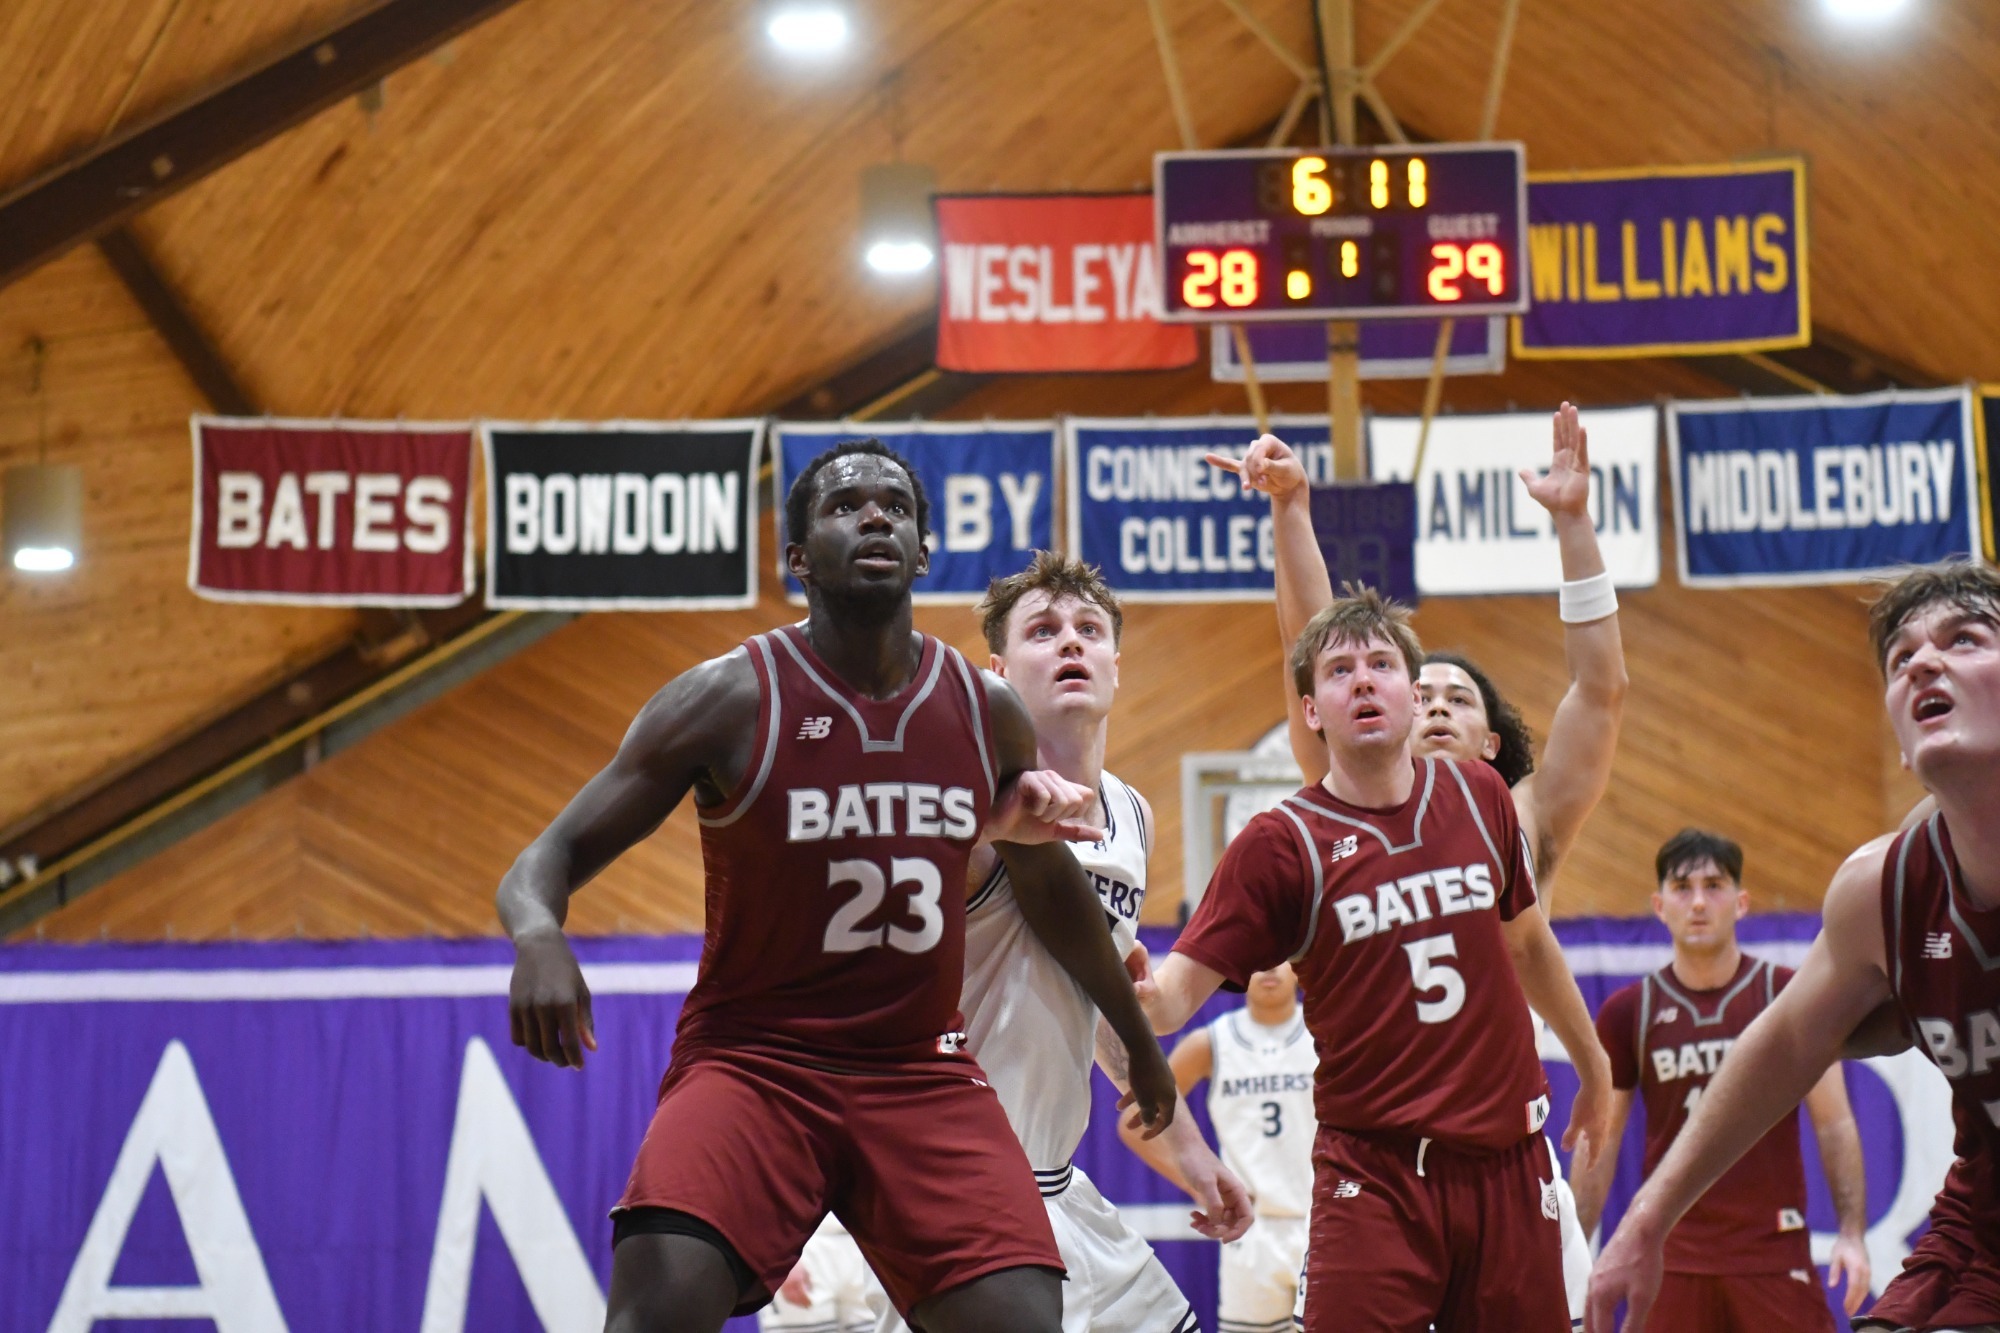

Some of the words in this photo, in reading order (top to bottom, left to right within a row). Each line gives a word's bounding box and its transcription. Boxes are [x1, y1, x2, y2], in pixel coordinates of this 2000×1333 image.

[1292, 157, 1332, 216] 6
[1427, 213, 1498, 240] GUEST
[945, 243, 1163, 322] WESLEYA
[1183, 250, 1258, 308] 28
[1341, 241, 1358, 278] 1
[1428, 243, 1504, 301] 29
[1529, 214, 1788, 302] WILLIAMS
[217, 472, 452, 554] BATES
[505, 472, 738, 555] BOWDOIN
[1686, 440, 1955, 535] MIDDLEBURY
[1120, 515, 1276, 574] COLLEG
[787, 783, 978, 844] BATES
[822, 857, 944, 955] 23
[1332, 863, 1497, 946] BATES
[1402, 933, 1467, 1025] 5
[1220, 1073, 1313, 1098] AMHERS
[1652, 1039, 1737, 1083] BAT
[1261, 1101, 1283, 1139] 3
